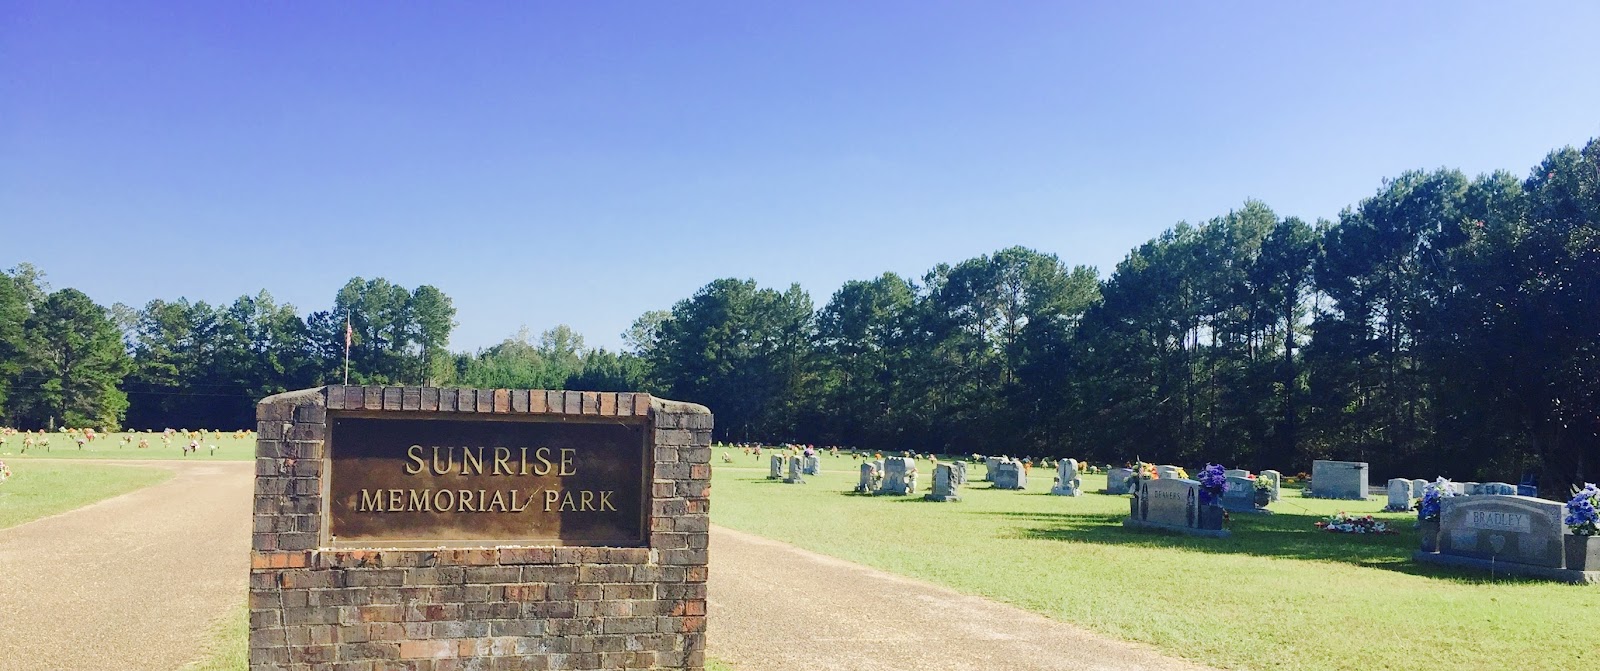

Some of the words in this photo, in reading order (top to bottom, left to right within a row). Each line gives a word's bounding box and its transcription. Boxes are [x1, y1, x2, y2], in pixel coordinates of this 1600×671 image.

[404, 444, 577, 476] SUNRISE
[359, 488, 527, 513] MEMORIAL
[543, 490, 617, 512] PARK
[1473, 511, 1522, 526] BRADLEY
